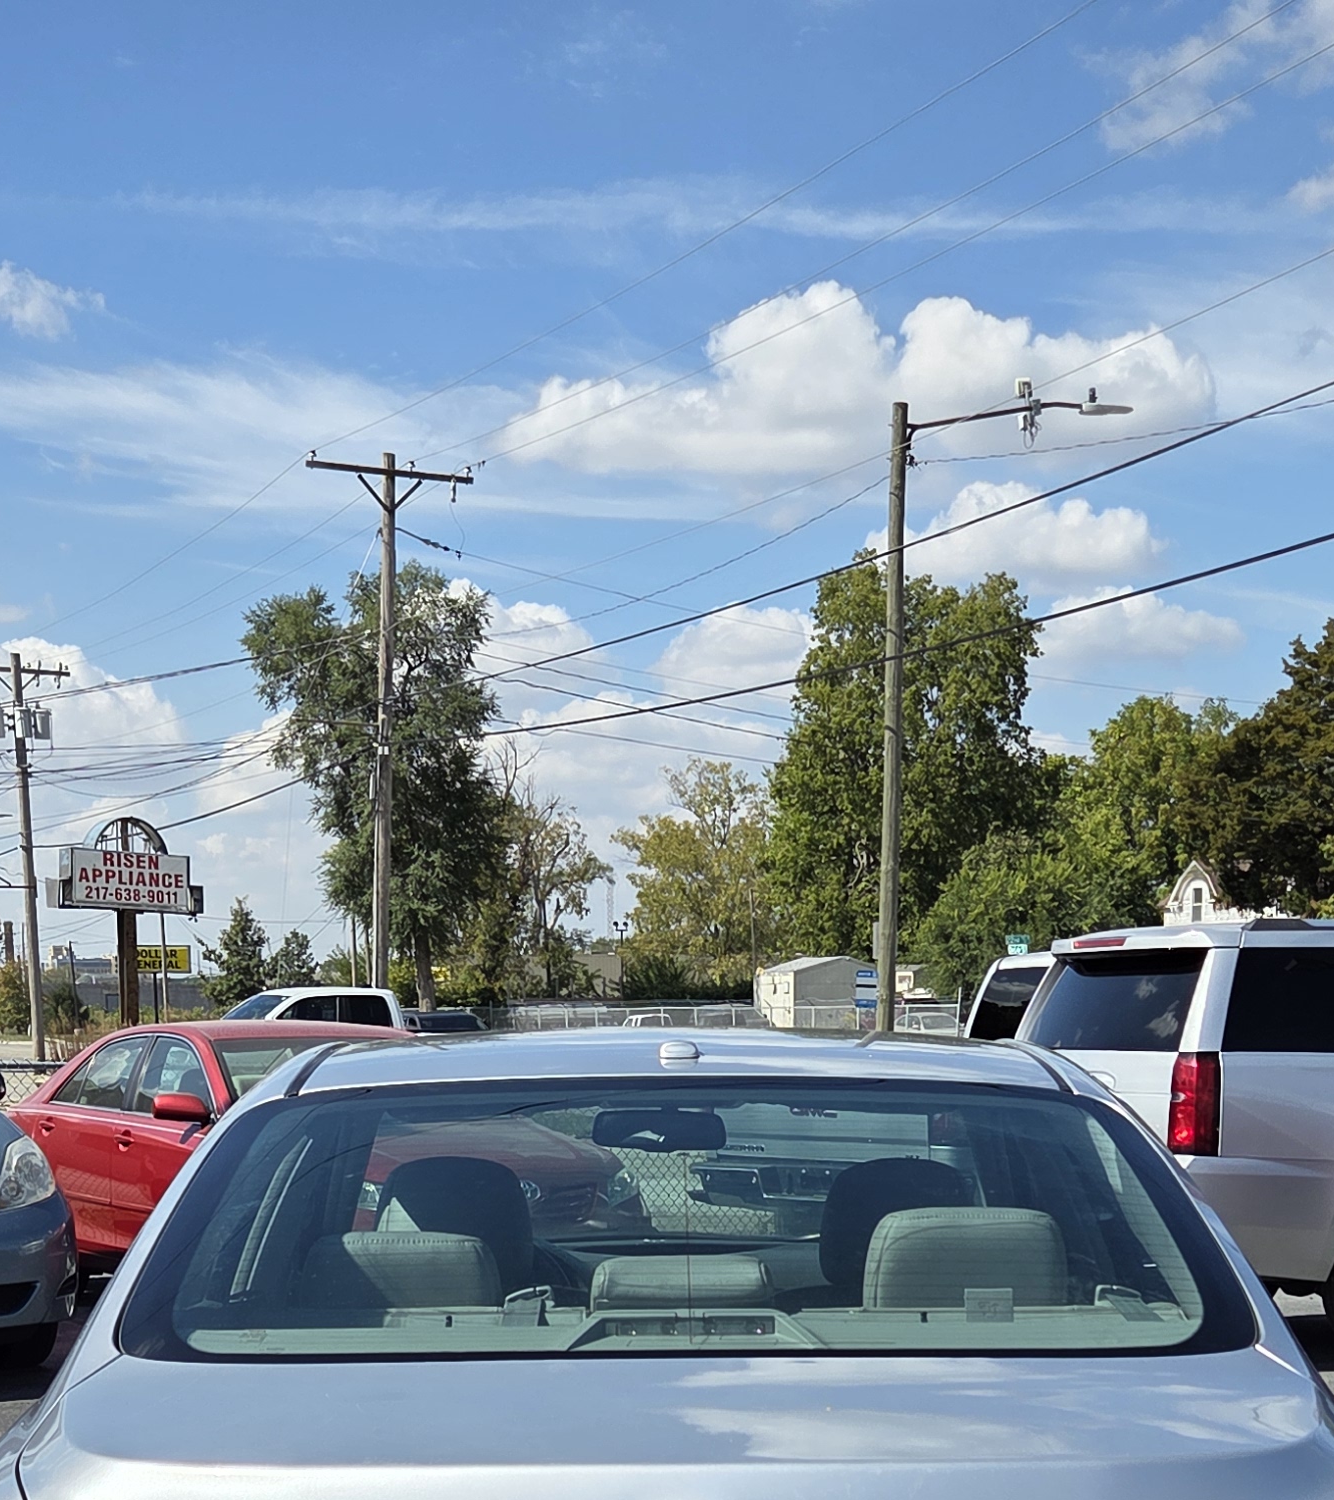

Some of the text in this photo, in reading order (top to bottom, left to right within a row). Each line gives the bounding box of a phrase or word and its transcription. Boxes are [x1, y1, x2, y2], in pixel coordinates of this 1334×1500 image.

[102, 851, 160, 870] RISEN
[78, 867, 184, 889] APPLIANCE
[85, 885, 179, 905] 217-638-9011
[136, 949, 178, 959] OLLR
[137, 959, 181, 969] ENEAL
